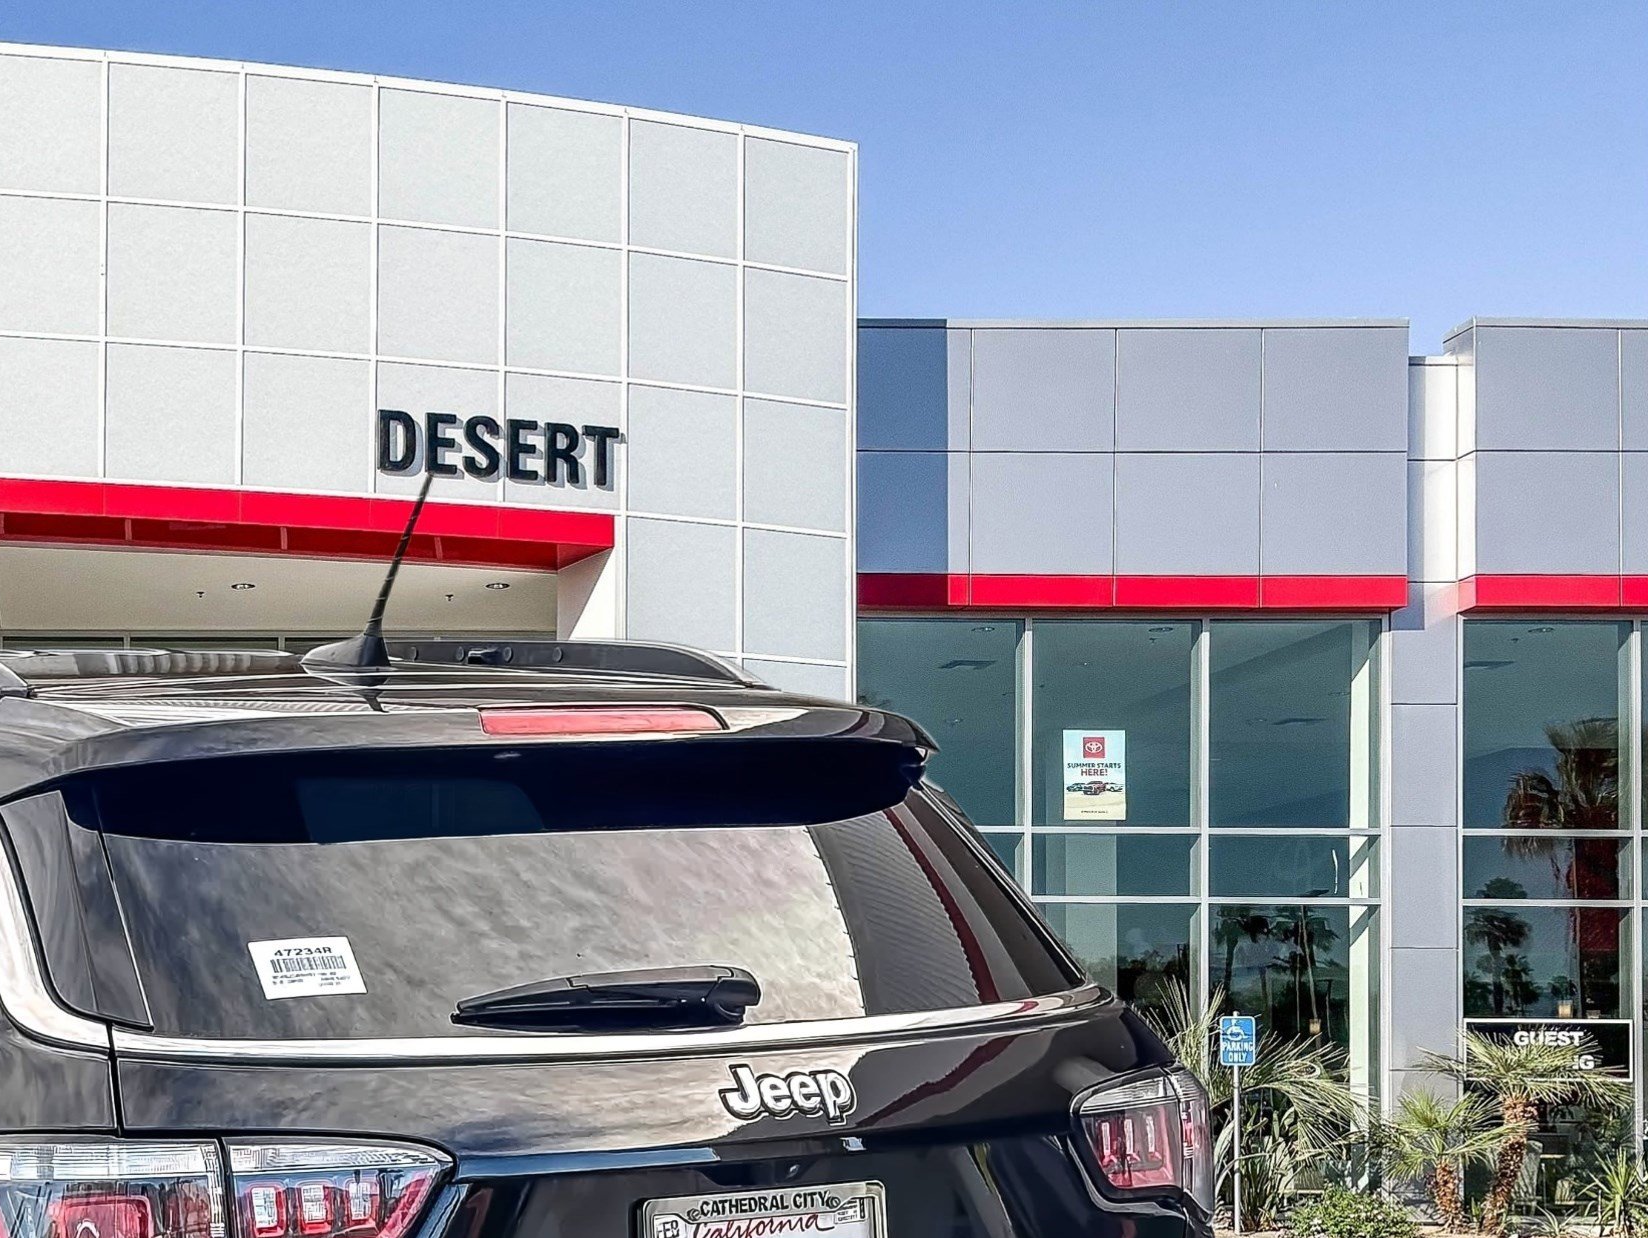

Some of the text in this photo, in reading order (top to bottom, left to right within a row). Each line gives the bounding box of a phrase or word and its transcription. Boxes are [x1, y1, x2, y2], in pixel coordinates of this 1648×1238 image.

[377, 410, 619, 486] DESERT
[274, 946, 333, 957] 47234R
[1222, 1041, 1254, 1051] PARKING
[1513, 1030, 1584, 1046] GUEST
[1228, 1051, 1247, 1062] ONLY
[718, 1063, 857, 1125] Jeep
[700, 1190, 829, 1217] CATHEDRAL CITY
